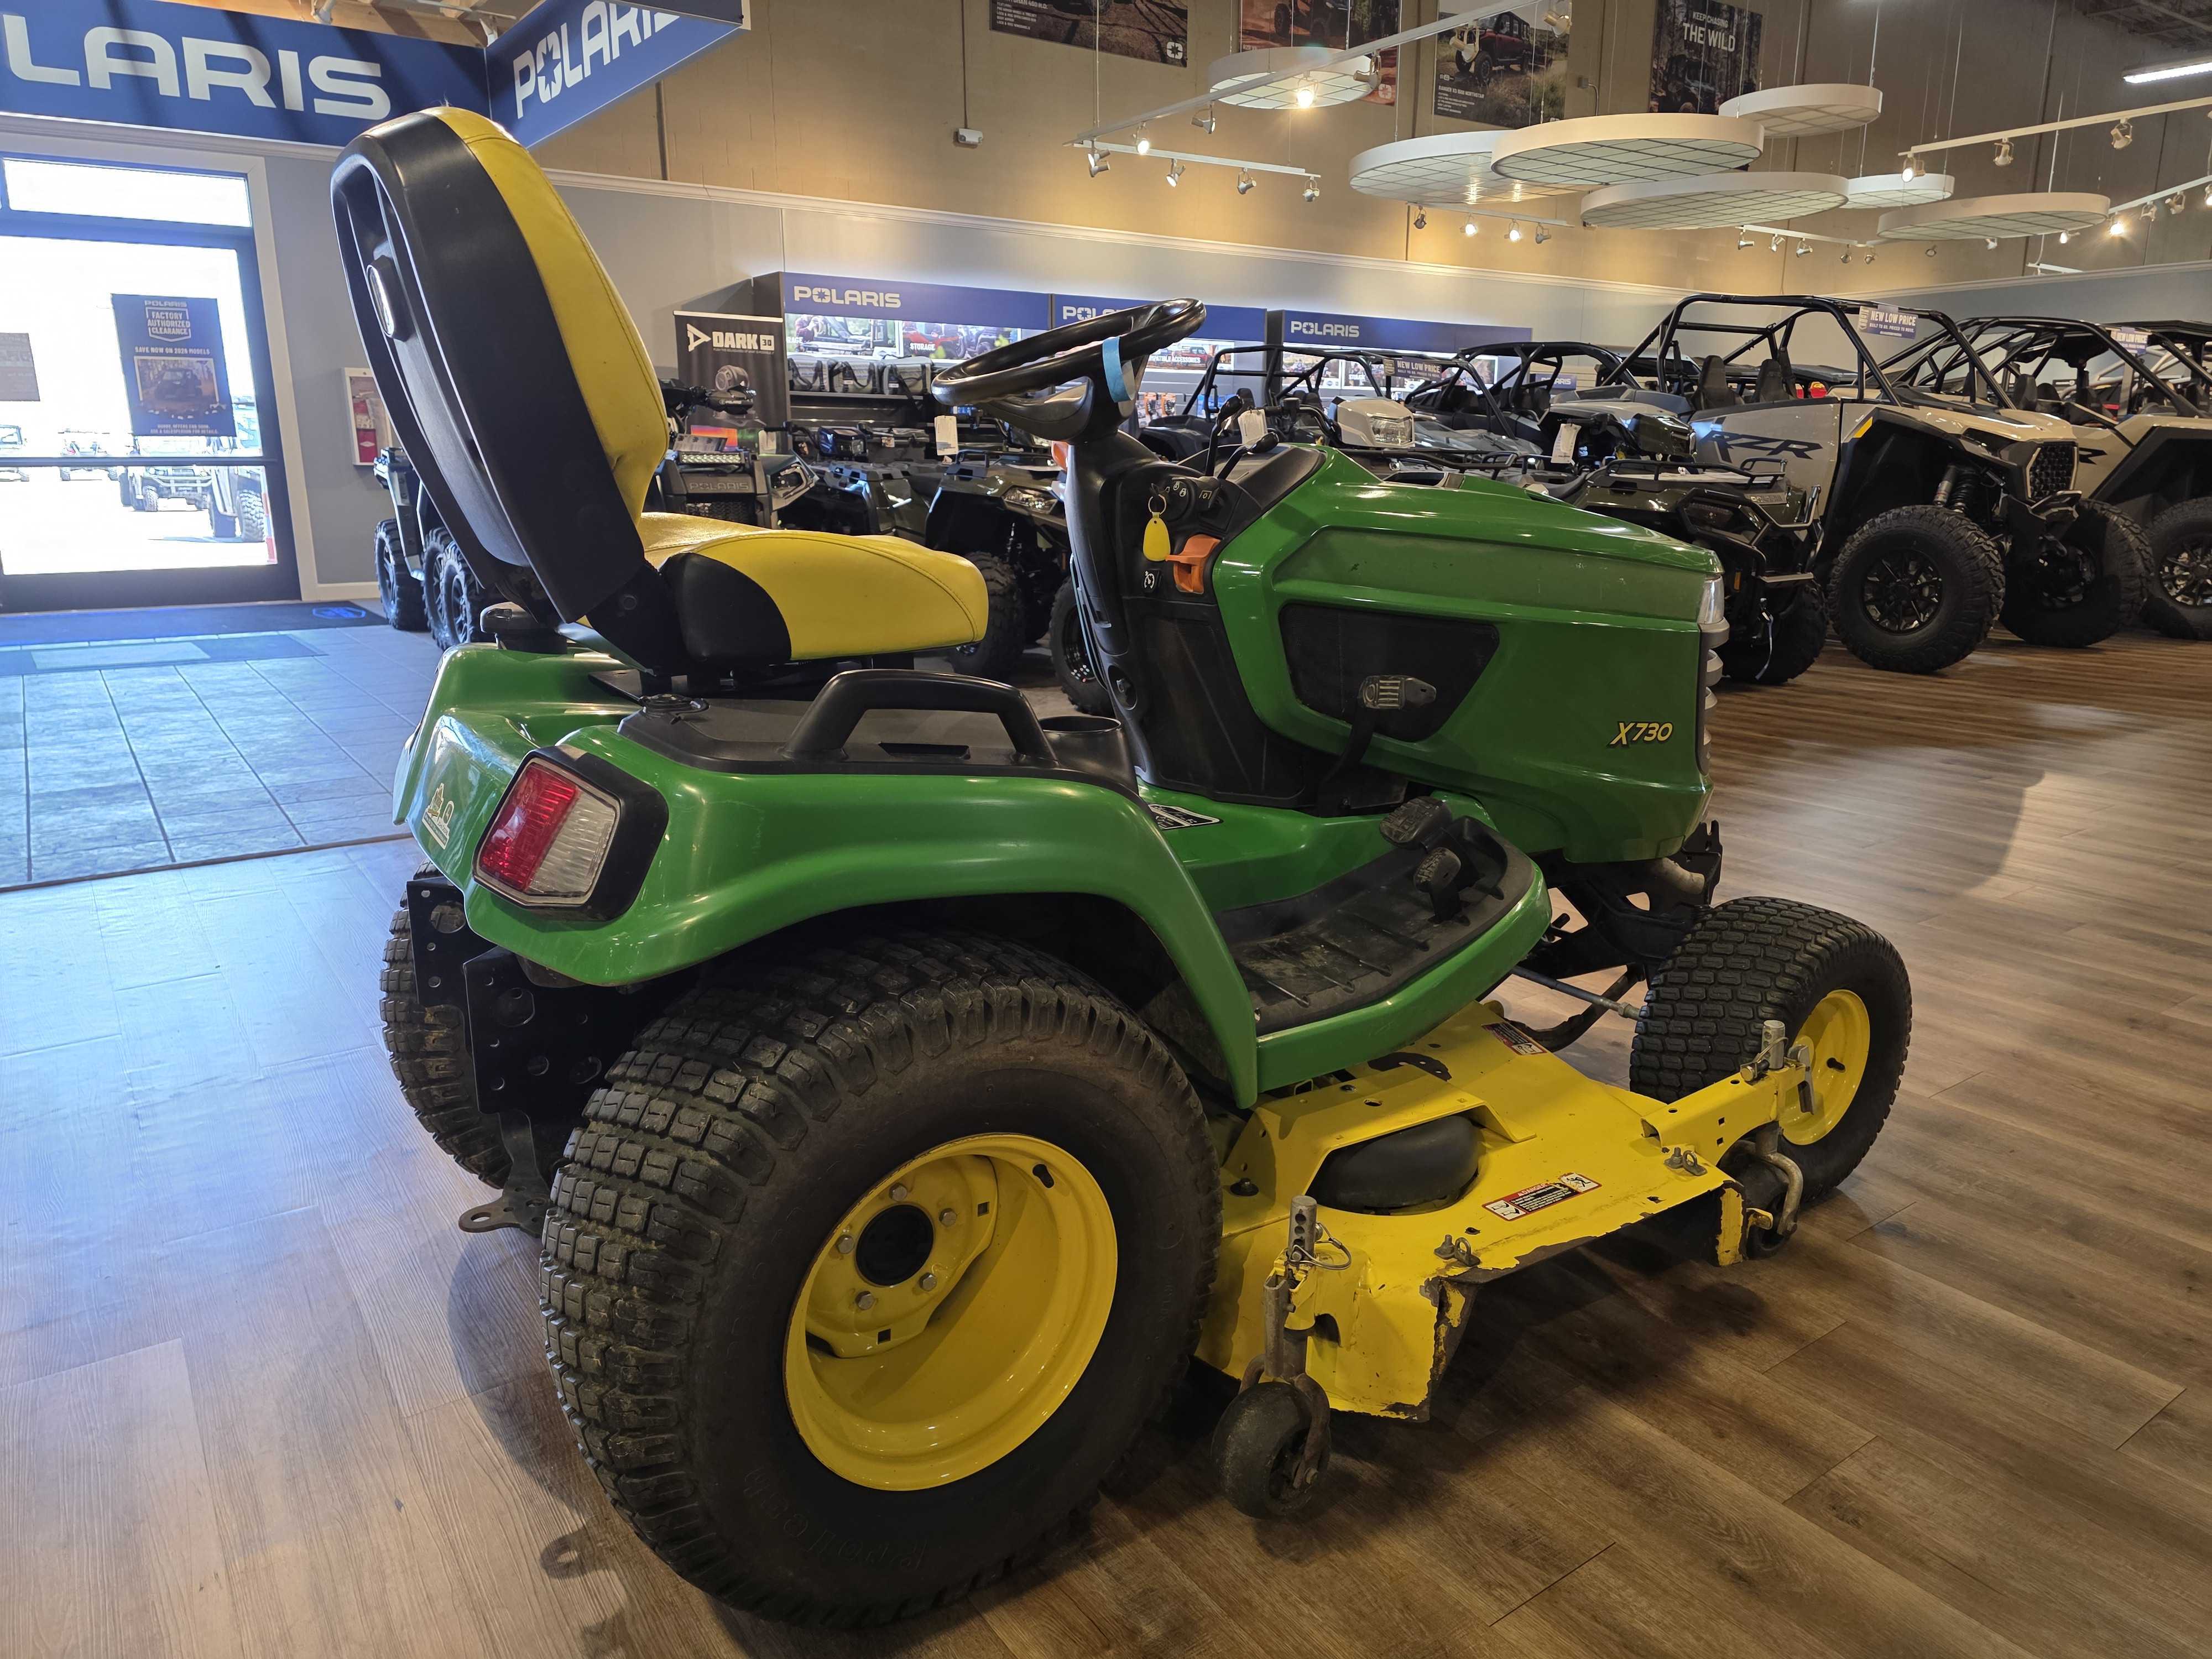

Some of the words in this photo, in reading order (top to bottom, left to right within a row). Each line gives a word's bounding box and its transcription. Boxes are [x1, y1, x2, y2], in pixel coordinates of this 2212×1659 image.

[1693, 11, 1706, 22] KEEP
[1707, 15, 1729, 28] CHASING
[1683, 22, 1705, 44] THE
[1708, 29, 1735, 52] WILD
[794, 285, 901, 308] POLARIS
[148, 319, 190, 328] AUTHORIZED
[152, 311, 182, 320] FACTORY
[1870, 310, 1884, 321] NEW
[1885, 312, 1898, 324] LOW
[1898, 314, 1917, 326] PRICE
[1291, 321, 1360, 338] POLARIS
[712, 331, 758, 349] DARK
[910, 342, 936, 351] STORAGE
[1397, 360, 1410, 369] NEW
[1411, 362, 1423, 371] LOW
[1424, 364, 1441, 373] PRICE
[1699, 430, 1823, 460] RZR
[690, 482, 749, 491] POLARIS
[1609, 722, 1673, 745] X730
[1522, 1183, 1548, 1196] DANGER
